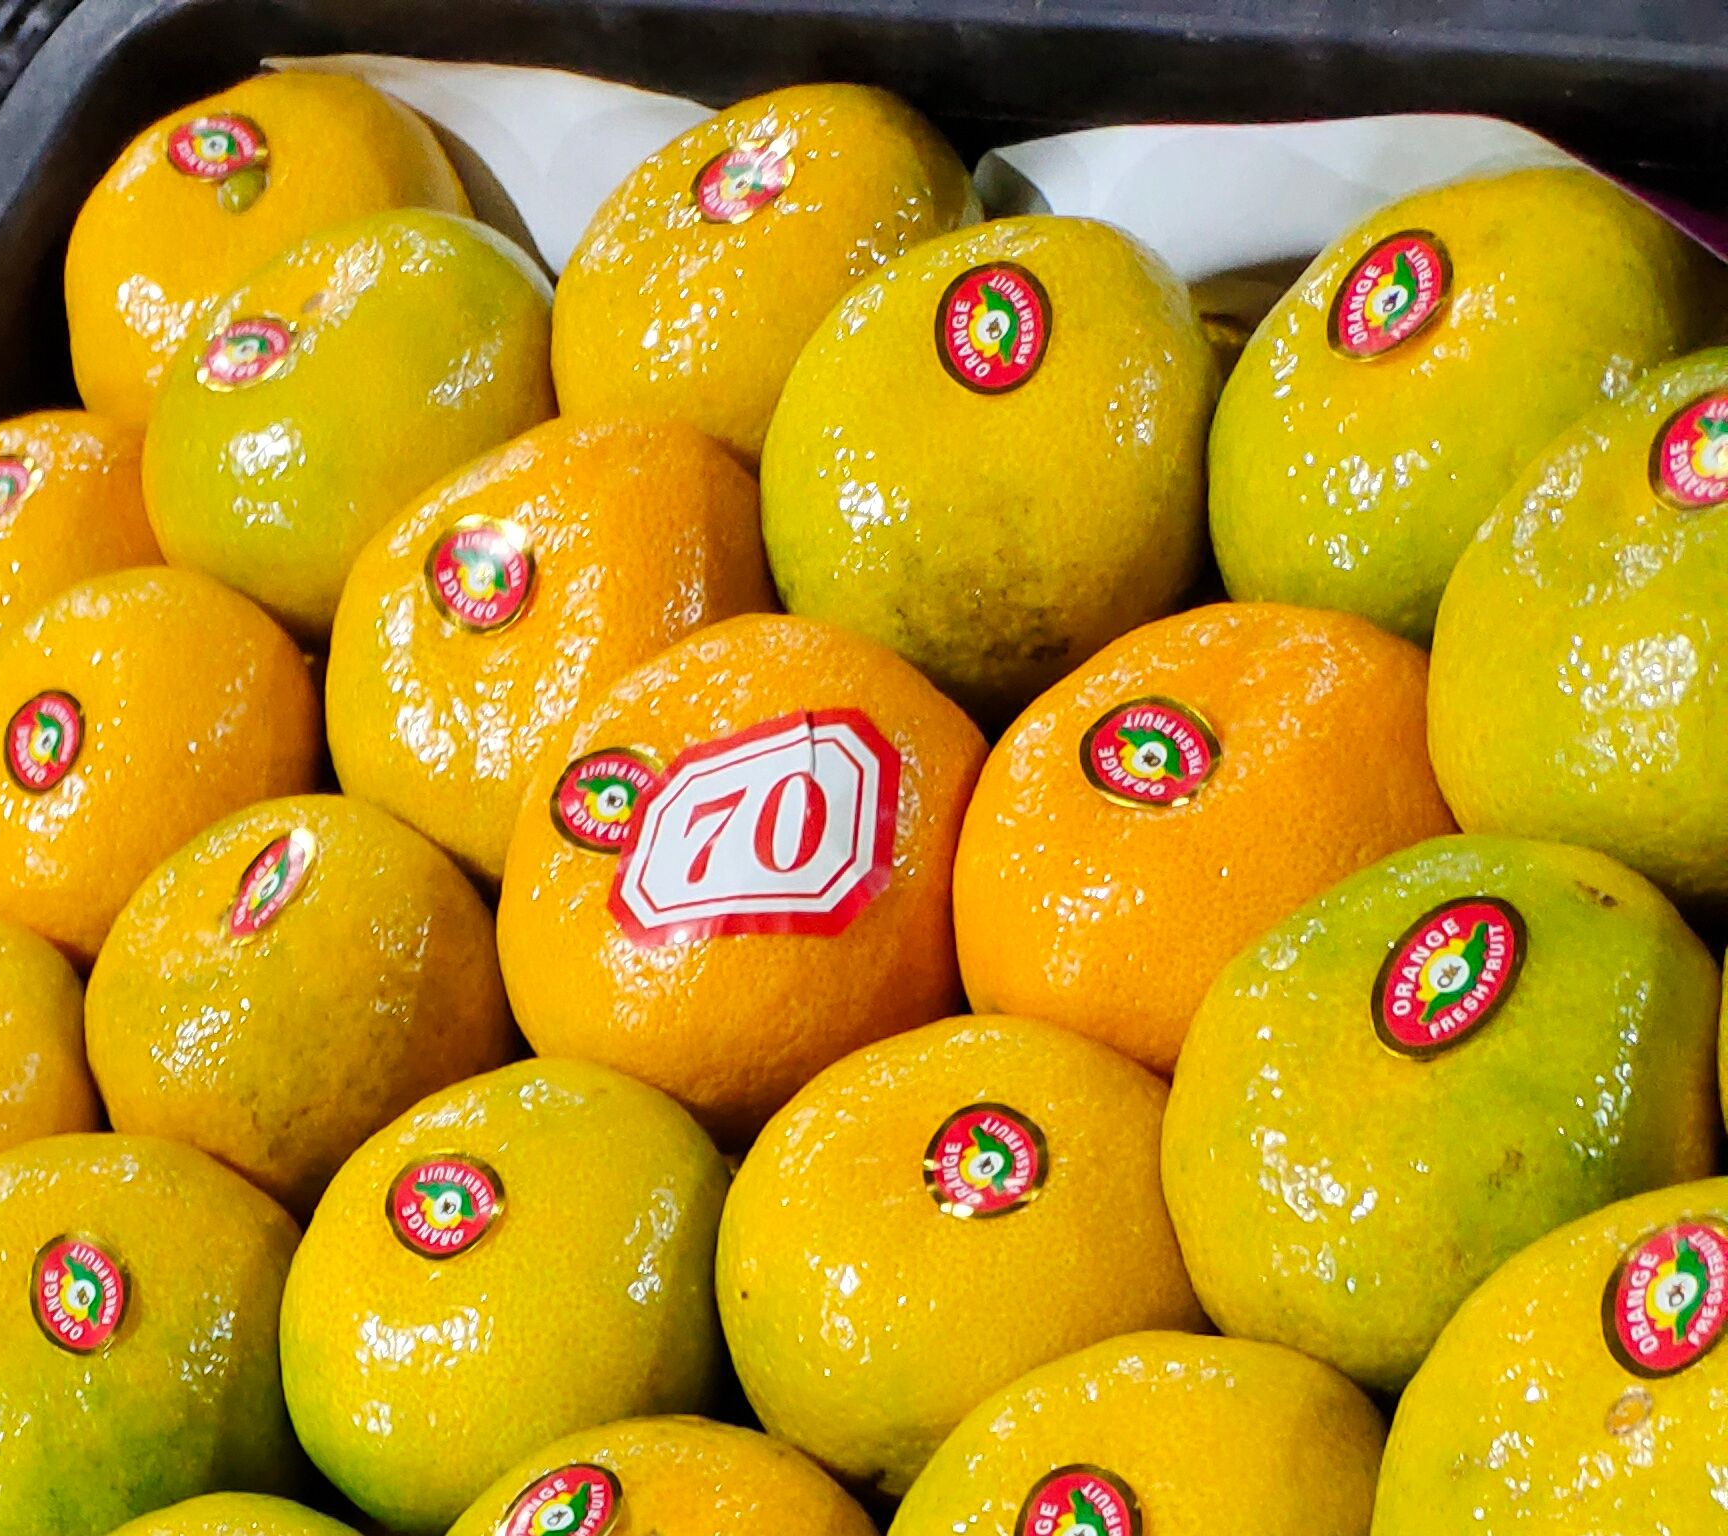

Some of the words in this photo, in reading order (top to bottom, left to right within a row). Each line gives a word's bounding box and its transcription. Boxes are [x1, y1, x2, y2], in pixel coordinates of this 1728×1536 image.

[952, 300, 991, 378] ORANGE
[1013, 309, 1035, 365] FRESH
[1347, 265, 1382, 345] ORANGE
[438, 568, 497, 620] ORANGE
[1124, 712, 1176, 738] FRUIT
[1097, 745, 1165, 797] ORANGE
[683, 771, 828, 884] 70
[1392, 918, 1460, 1018] ORANGE
[1428, 981, 1490, 1040] FRESH
[1480, 924, 1505, 983] FRUIT
[401, 1202, 465, 1246] ORANGE
[44, 1269, 84, 1342] ORANGE
[1625, 1252, 1660, 1355] ORANGE
[1080, 1481, 1122, 1527] FRUIT
